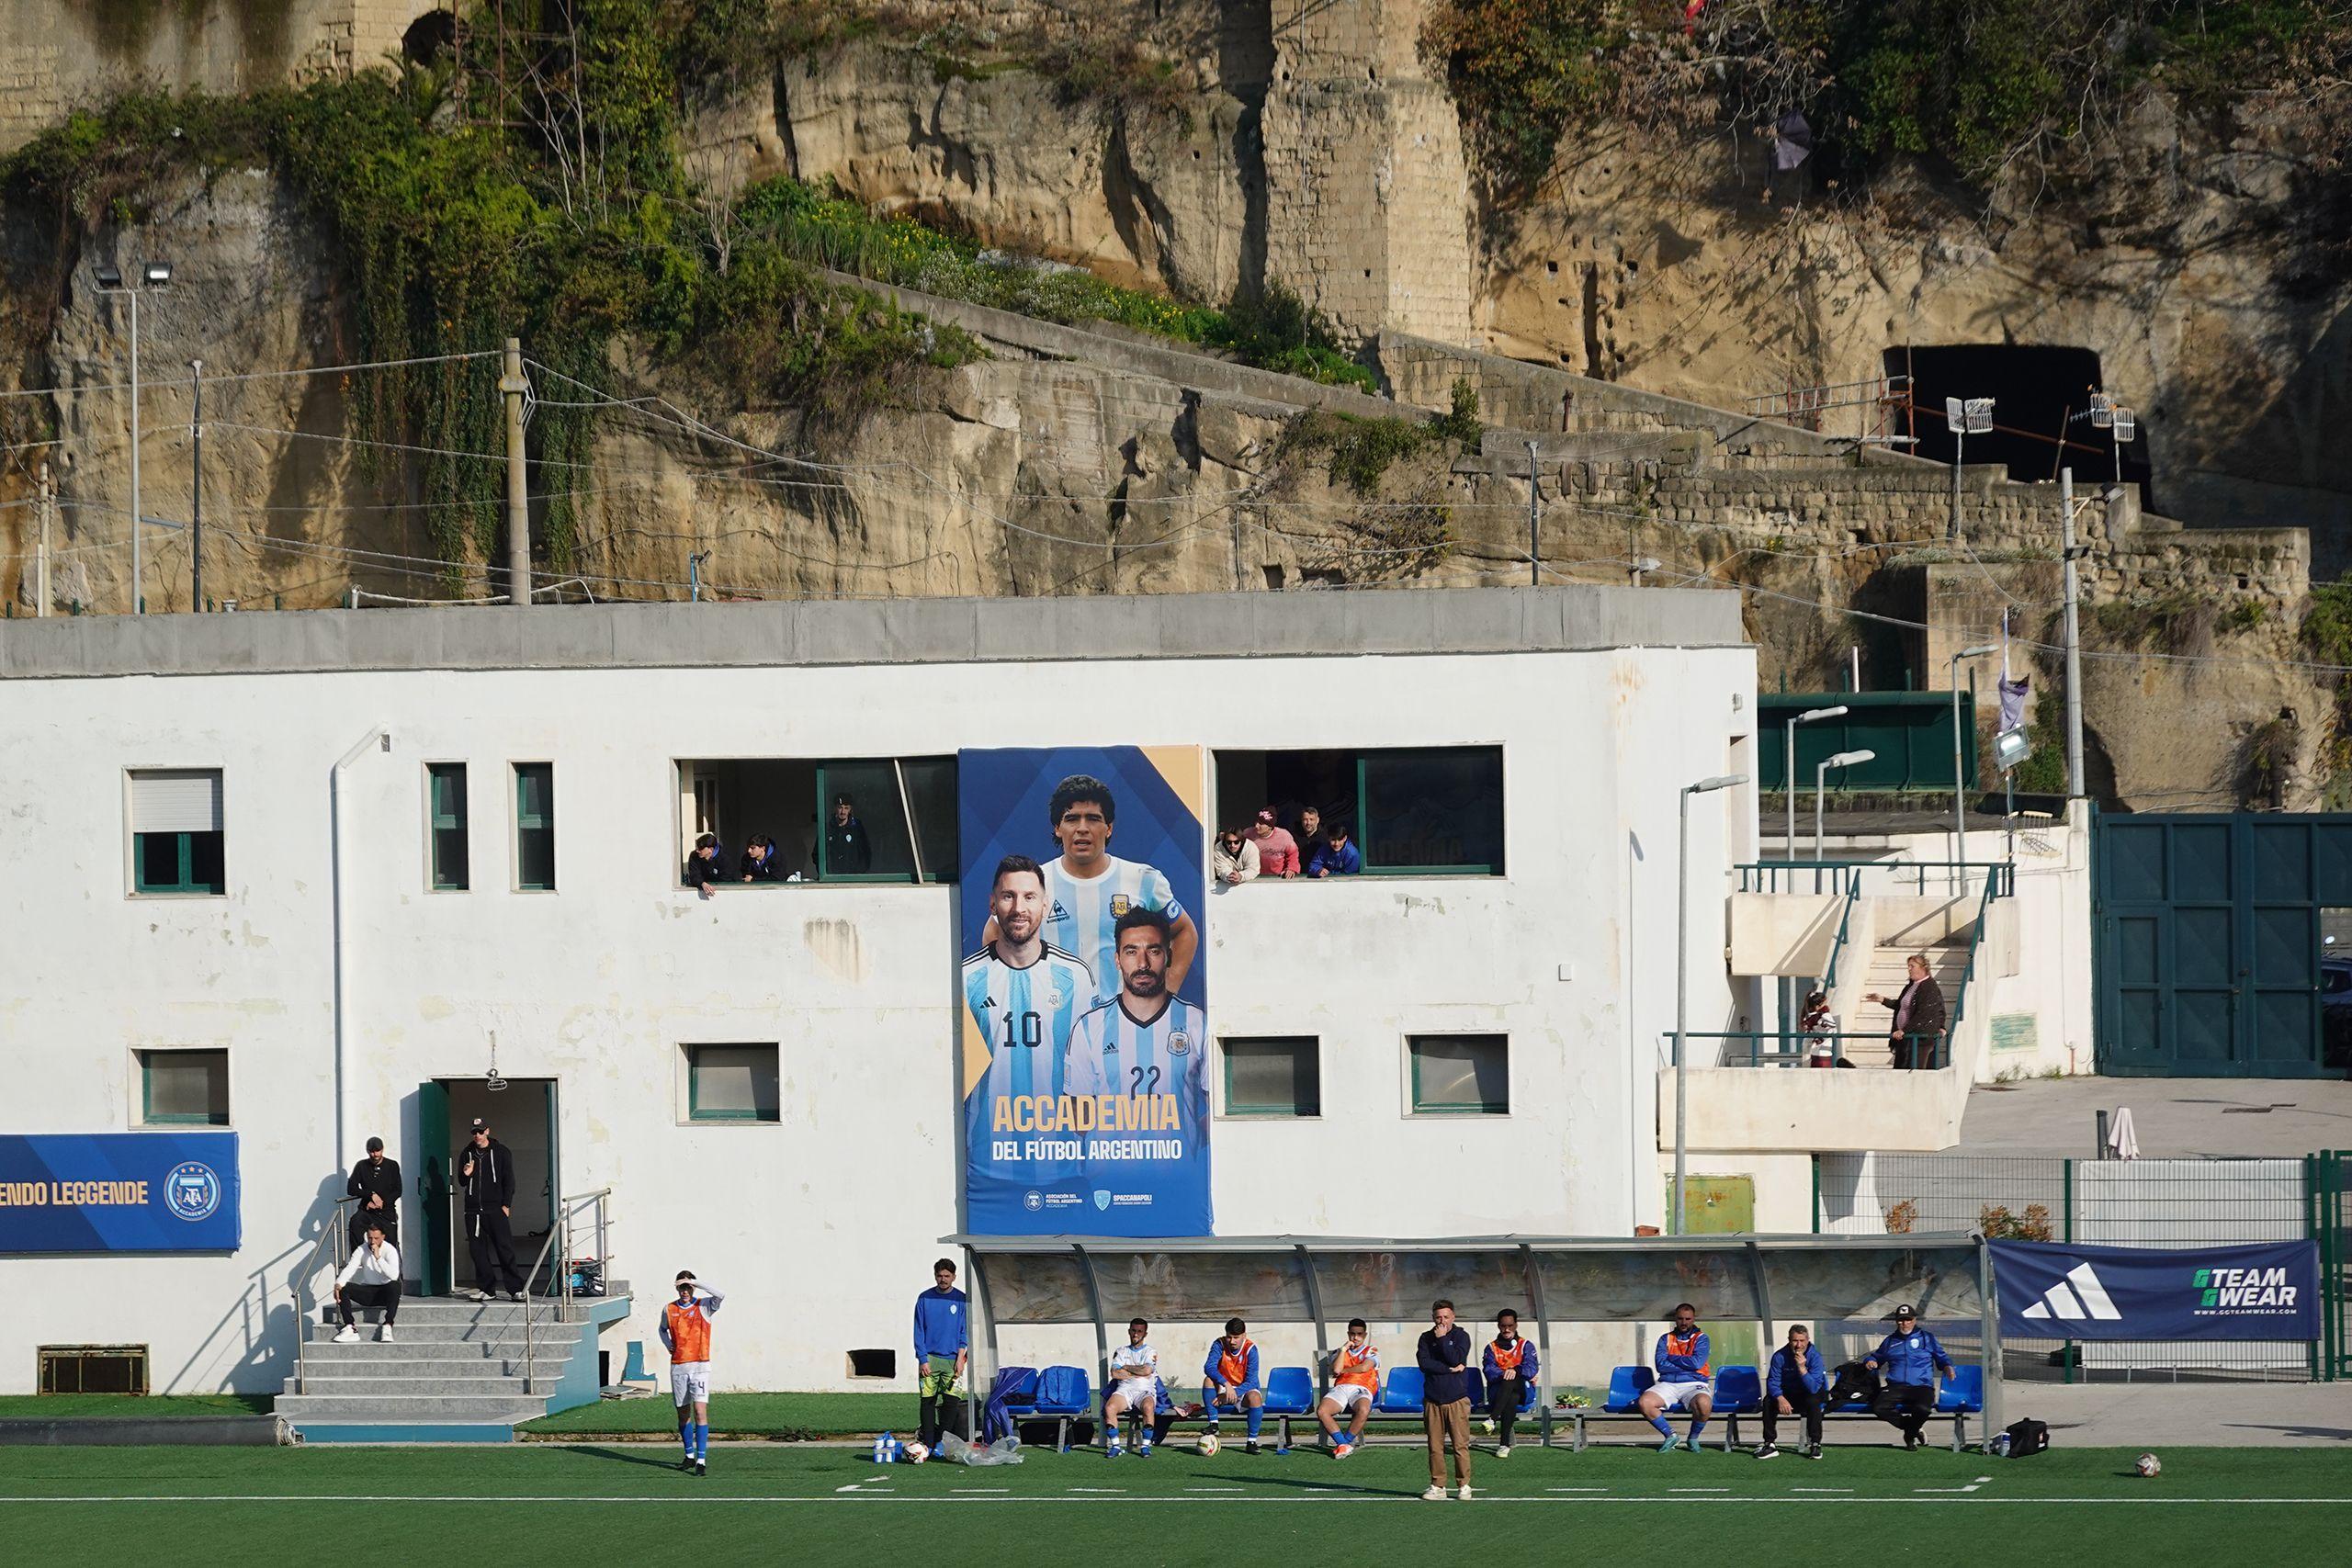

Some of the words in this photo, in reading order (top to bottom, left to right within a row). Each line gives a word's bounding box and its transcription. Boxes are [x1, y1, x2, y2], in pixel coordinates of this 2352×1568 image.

[1002, 1010, 1041, 1048] 10
[1131, 1066, 1160, 1100] 22
[993, 1095, 1181, 1132] ACCADEMIA
[993, 1140, 1022, 1161] DEL
[1025, 1136, 1085, 1161] FÚTBOL
[1089, 1139, 1182, 1160] ARGENTINO
[51, 1180, 149, 1205] LEGGENDE
[697, 1381, 705, 1393] 4
